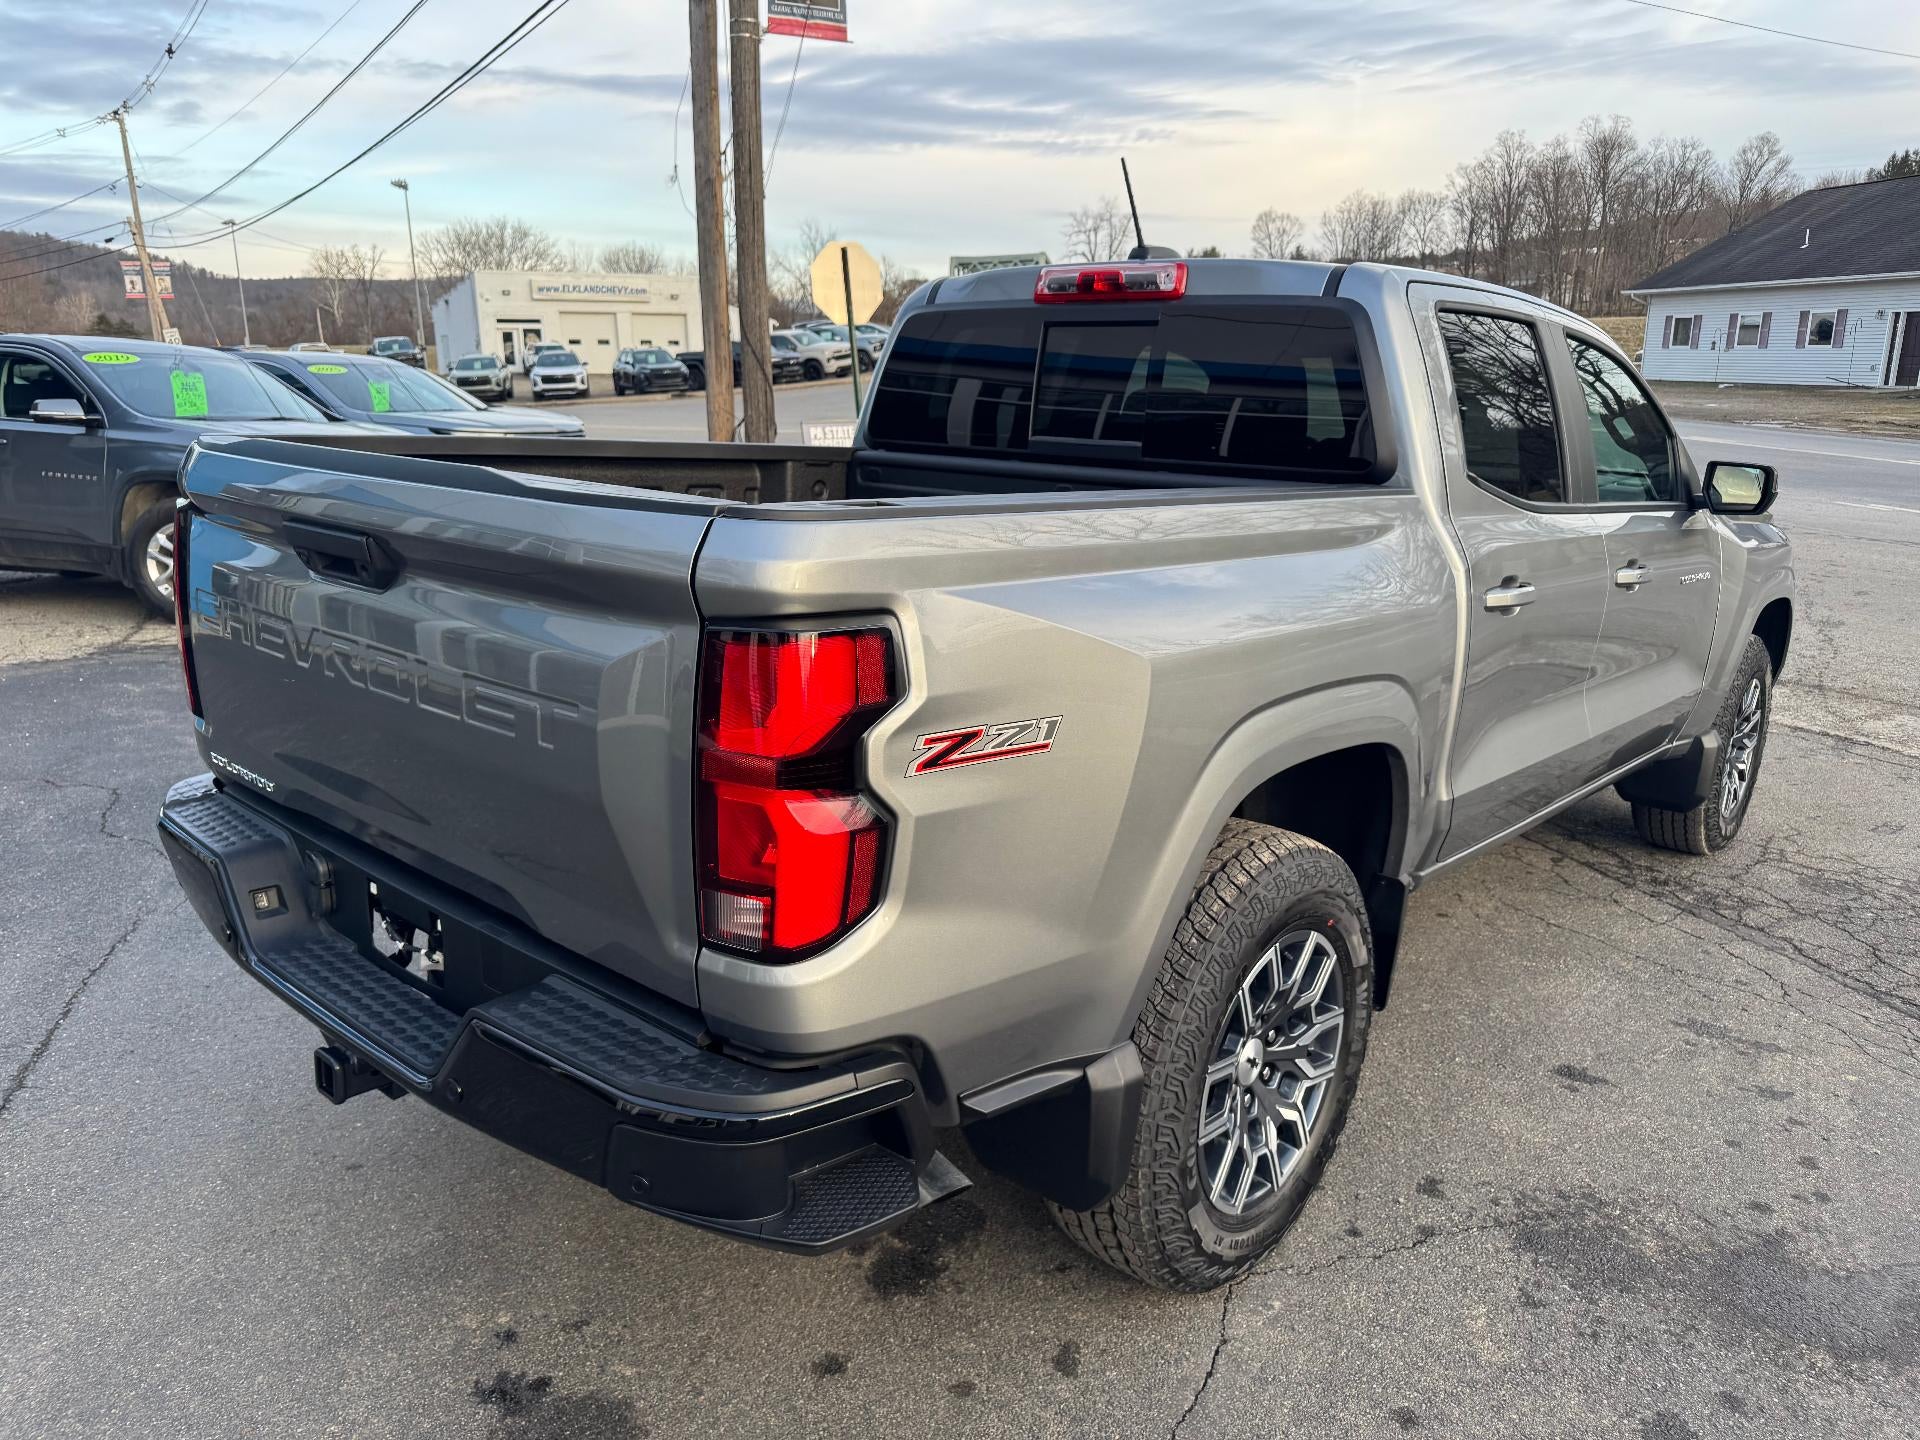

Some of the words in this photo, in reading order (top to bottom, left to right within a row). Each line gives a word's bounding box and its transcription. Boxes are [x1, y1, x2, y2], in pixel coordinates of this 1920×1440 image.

[537, 284, 648, 295] www.ELKLANDCHEVY.com
[93, 353, 131, 362] 2019
[194, 587, 581, 750] CHEVROLET
[904, 715, 1063, 778] Z71
[210, 751, 275, 792] COLORADO
